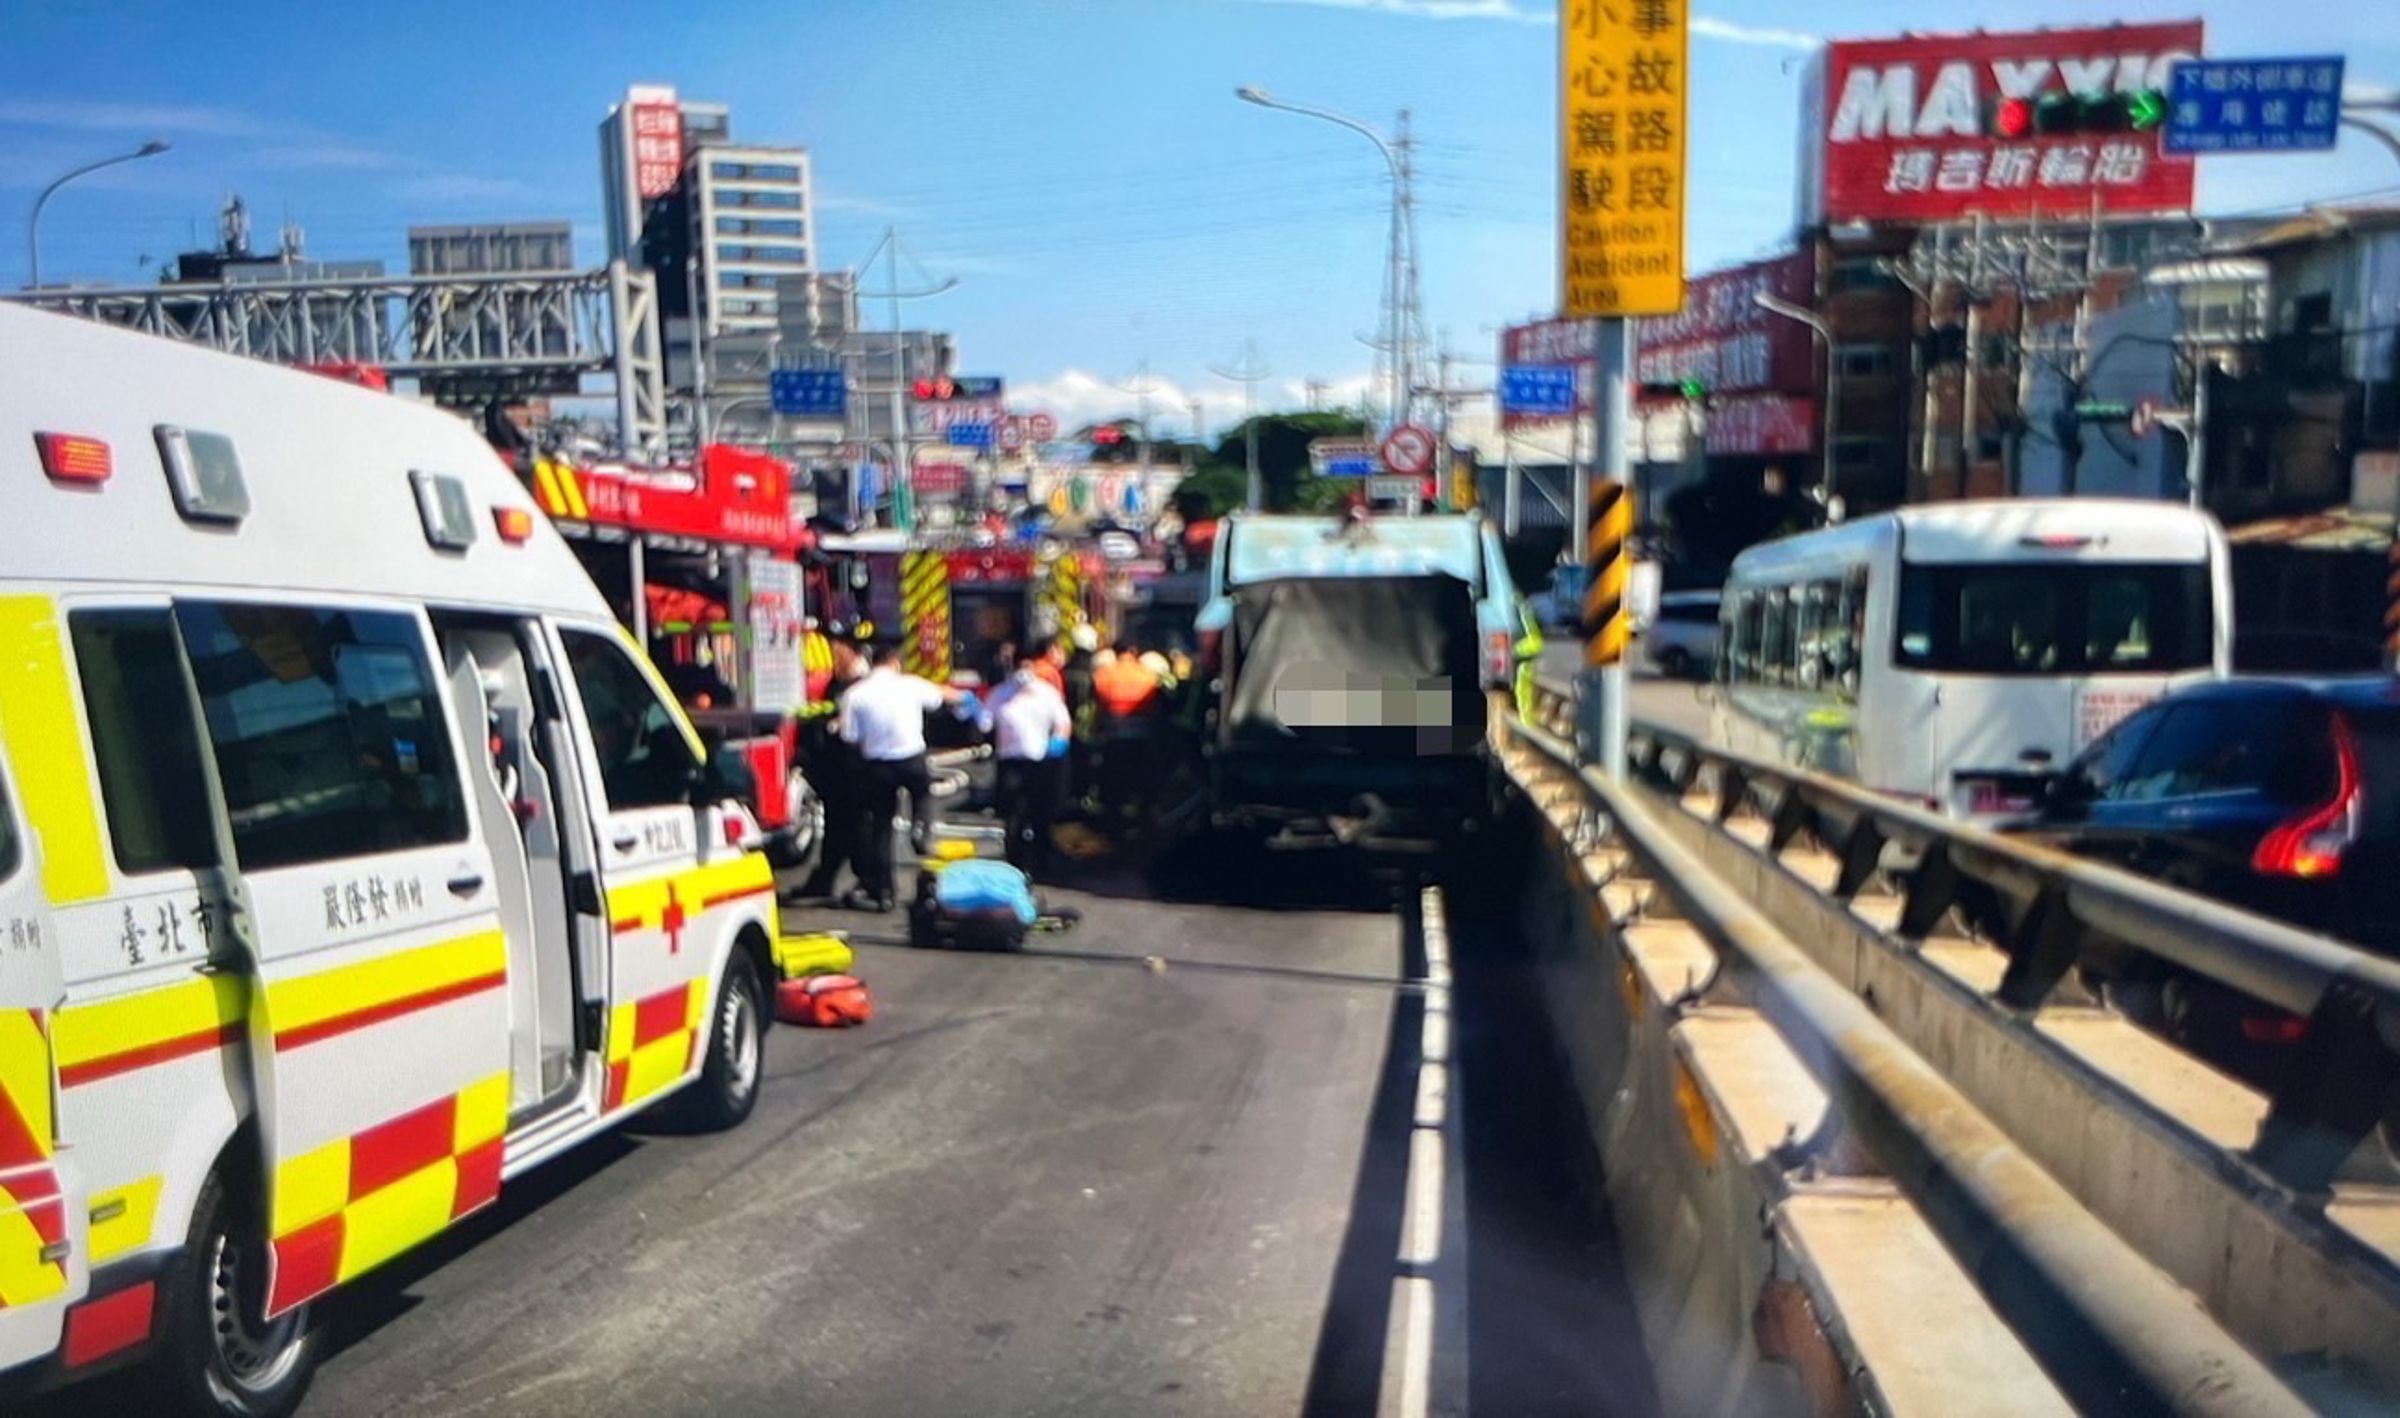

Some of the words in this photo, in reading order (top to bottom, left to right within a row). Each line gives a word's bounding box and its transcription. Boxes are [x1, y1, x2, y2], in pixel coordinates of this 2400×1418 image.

[1570, 0, 1617, 211] 小心駕駛
[1627, 0, 1674, 211] 事故路段
[1884, 143, 2146, 194] 瑪吉斯輪胎
[1569, 253, 1671, 277] Accident
[1569, 284, 1619, 307] Area
